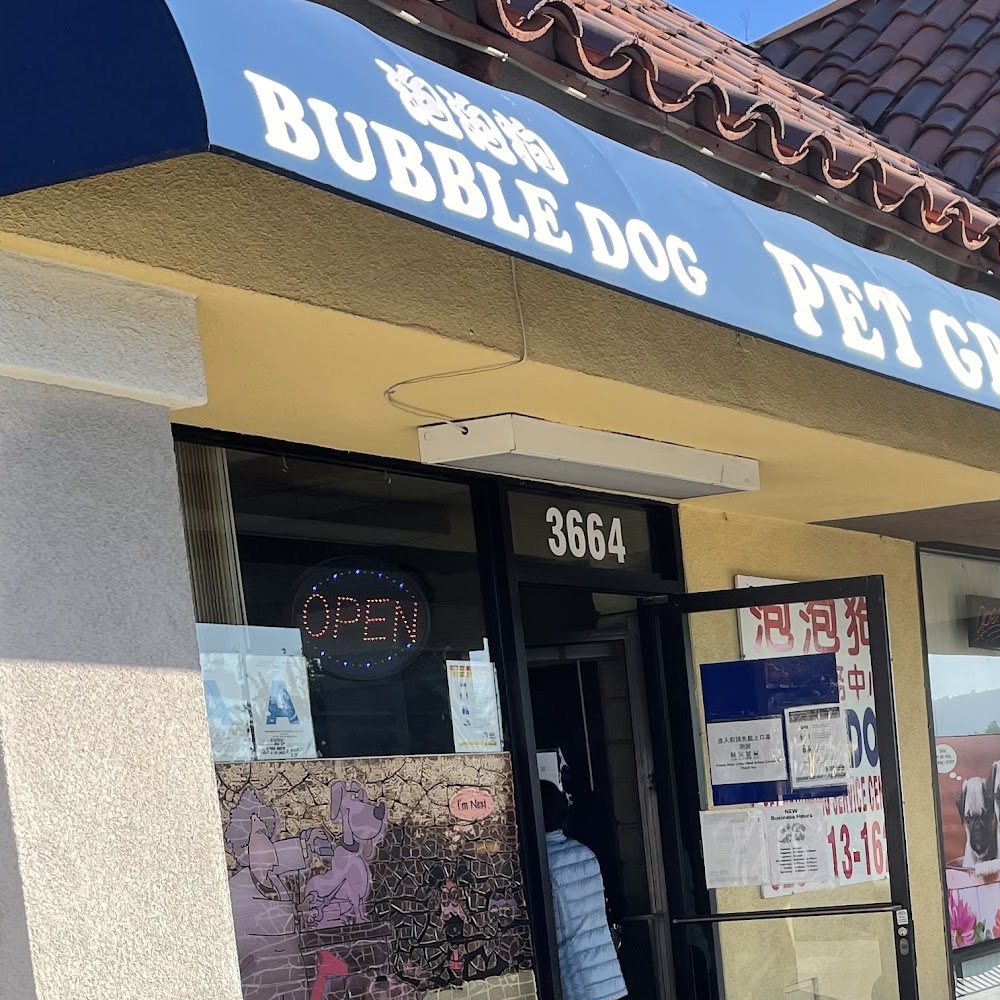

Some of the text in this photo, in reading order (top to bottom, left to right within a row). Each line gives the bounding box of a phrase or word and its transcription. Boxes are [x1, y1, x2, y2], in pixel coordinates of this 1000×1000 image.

[244, 70, 708, 296] BUBBLE DOG
[763, 240, 922, 369] PET
[545, 506, 627, 564] 3664
[302, 592, 419, 644] OPEN
[265, 680, 301, 725] A
[828, 821, 888, 879] 13-16
